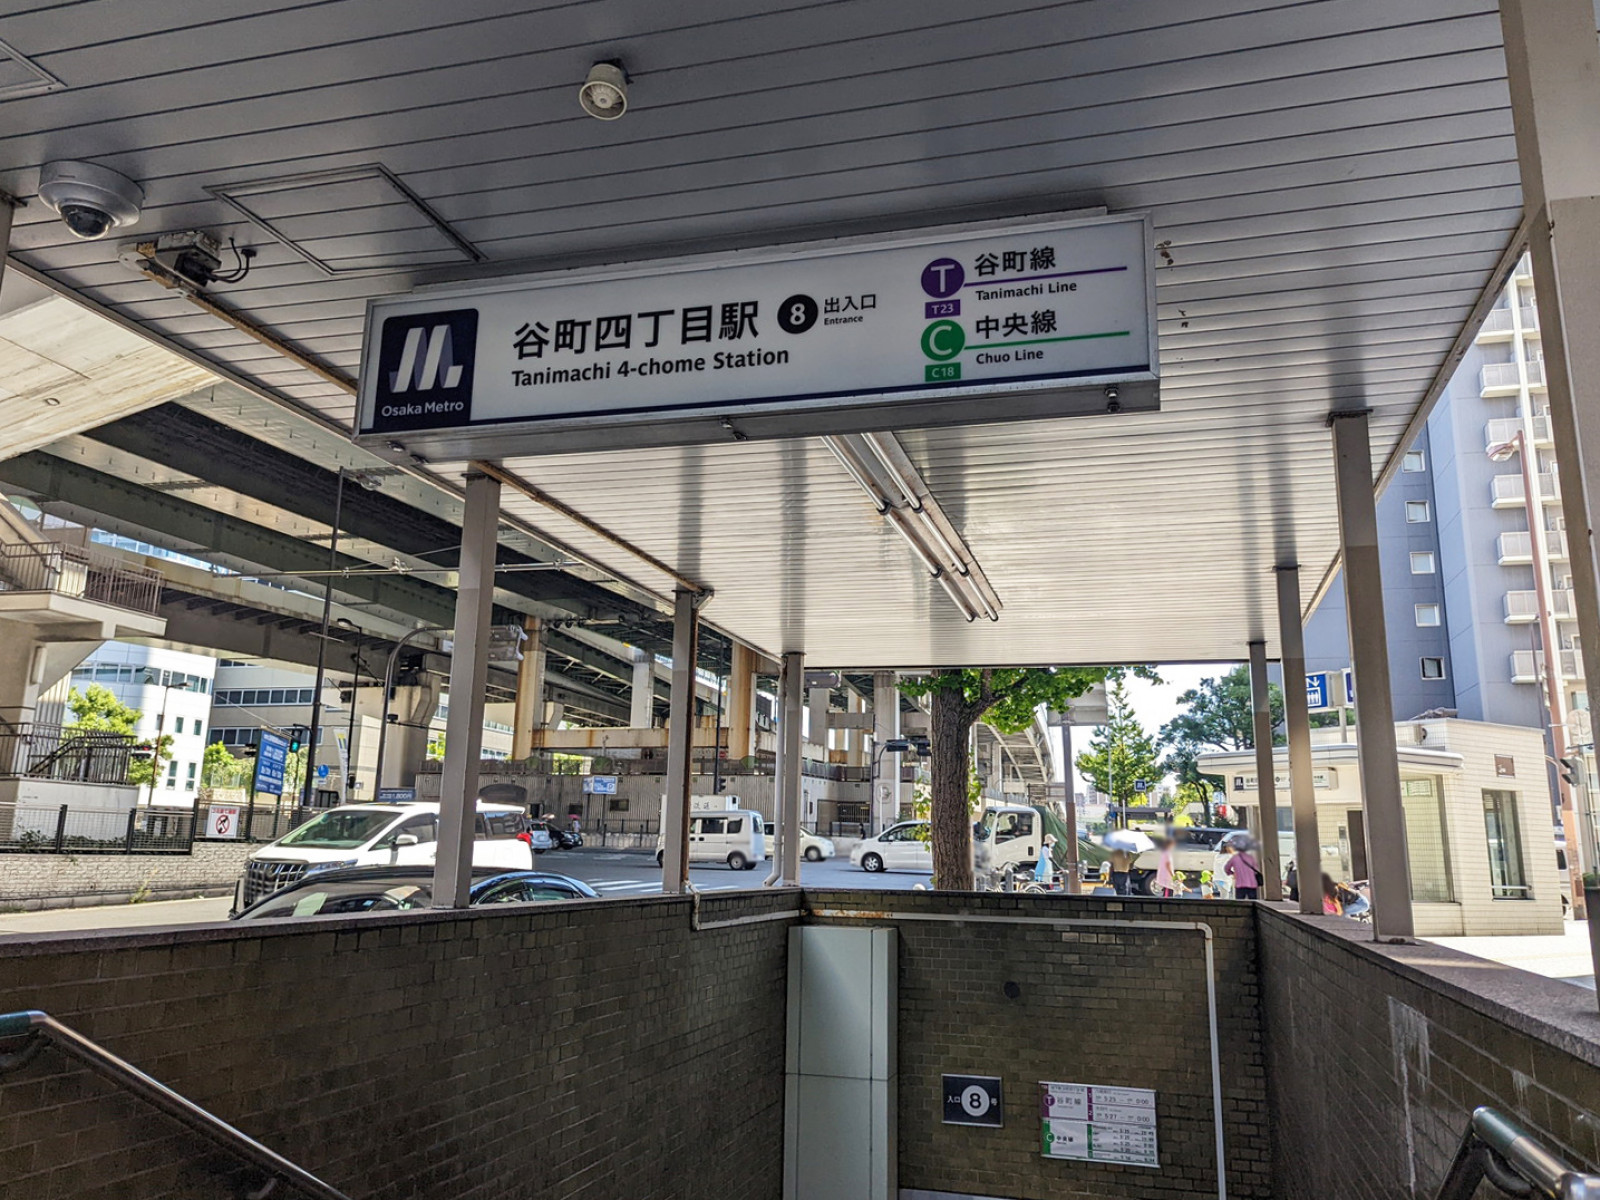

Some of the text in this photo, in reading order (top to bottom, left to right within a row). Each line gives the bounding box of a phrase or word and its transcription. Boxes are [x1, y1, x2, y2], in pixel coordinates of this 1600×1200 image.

[974, 246, 1056, 277] 谷町線
[930, 264, 955, 293] T
[976, 281, 1077, 301] Tanimachi Line
[789, 294, 876, 326] 8 出入口
[824, 315, 863, 326] Entrance
[931, 303, 954, 315] T23
[512, 300, 759, 360] 谷町四丁目駅
[976, 309, 1057, 340] 中央線
[929, 325, 953, 356] C
[512, 348, 789, 388] Tanimachi 4-chome Station
[976, 350, 1044, 365] Chuo Line
[931, 367, 955, 379] C18
[381, 400, 464, 417] Osaka Metro
[947, 1095, 961, 1104] 入口
[969, 1092, 982, 1110] 8
